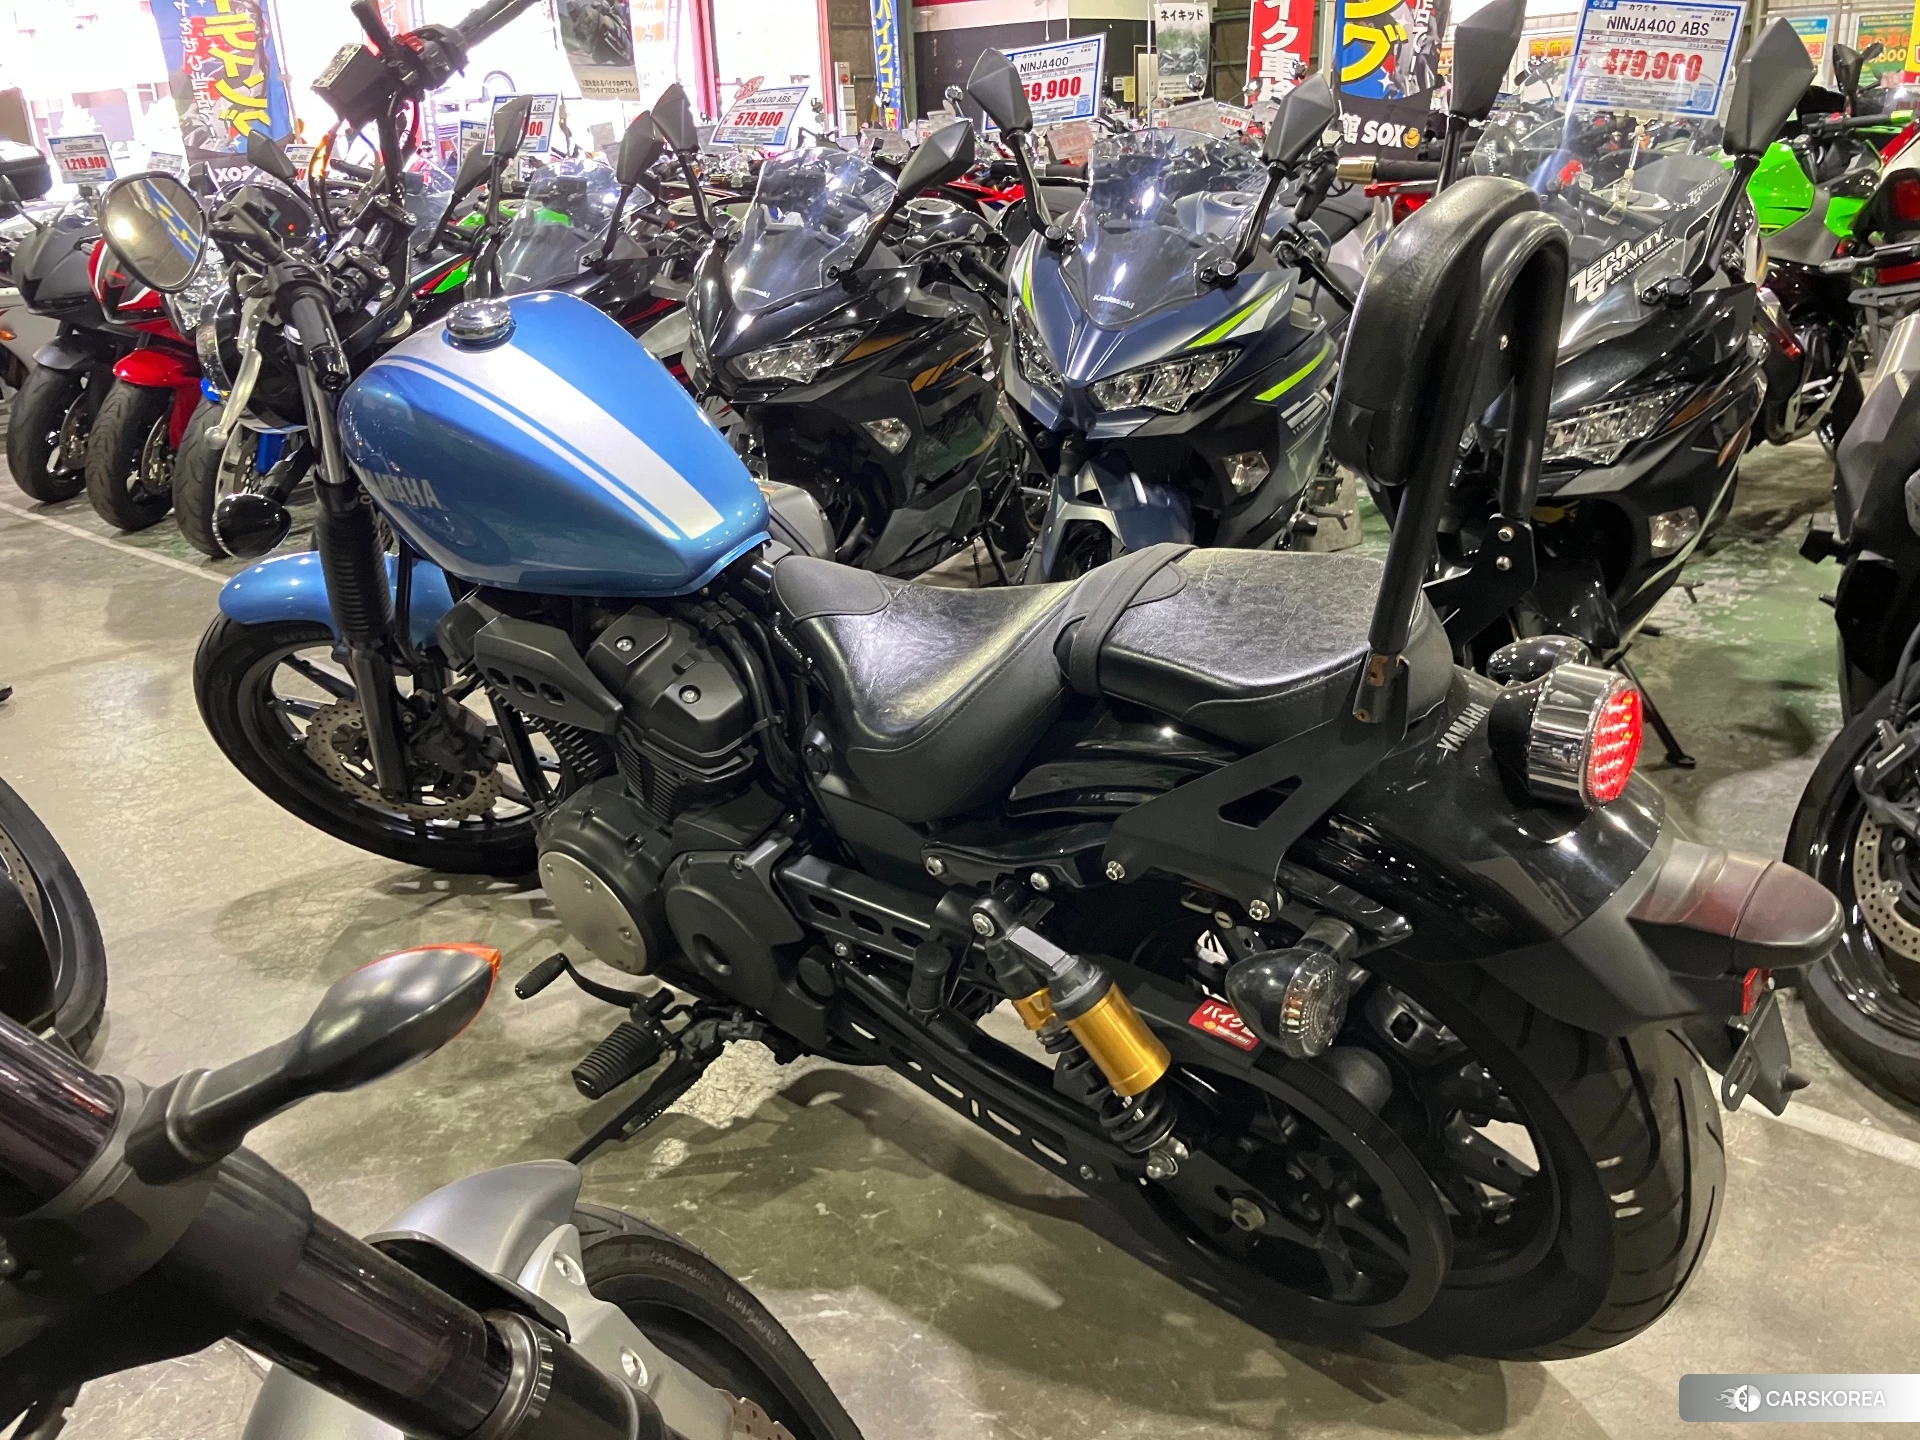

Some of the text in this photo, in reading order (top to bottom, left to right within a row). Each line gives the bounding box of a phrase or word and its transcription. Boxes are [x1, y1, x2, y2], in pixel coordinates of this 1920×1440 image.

[1160, 9, 1204, 22] ネイキッド
[1606, 16, 1710, 36] NINJA400 ABS
[1020, 57, 1069, 73] NINJA400
[1602, 48, 1703, 82] 479,900
[776, 95, 792, 103] ABS
[532, 104, 546, 112] ABS
[734, 111, 784, 127] 579,900
[1361, 120, 1407, 148] SOX
[1569, 240, 1631, 303] ZERO
[1092, 294, 1135, 310] Kawasaki
[1436, 702, 1490, 752] YAMAHA
